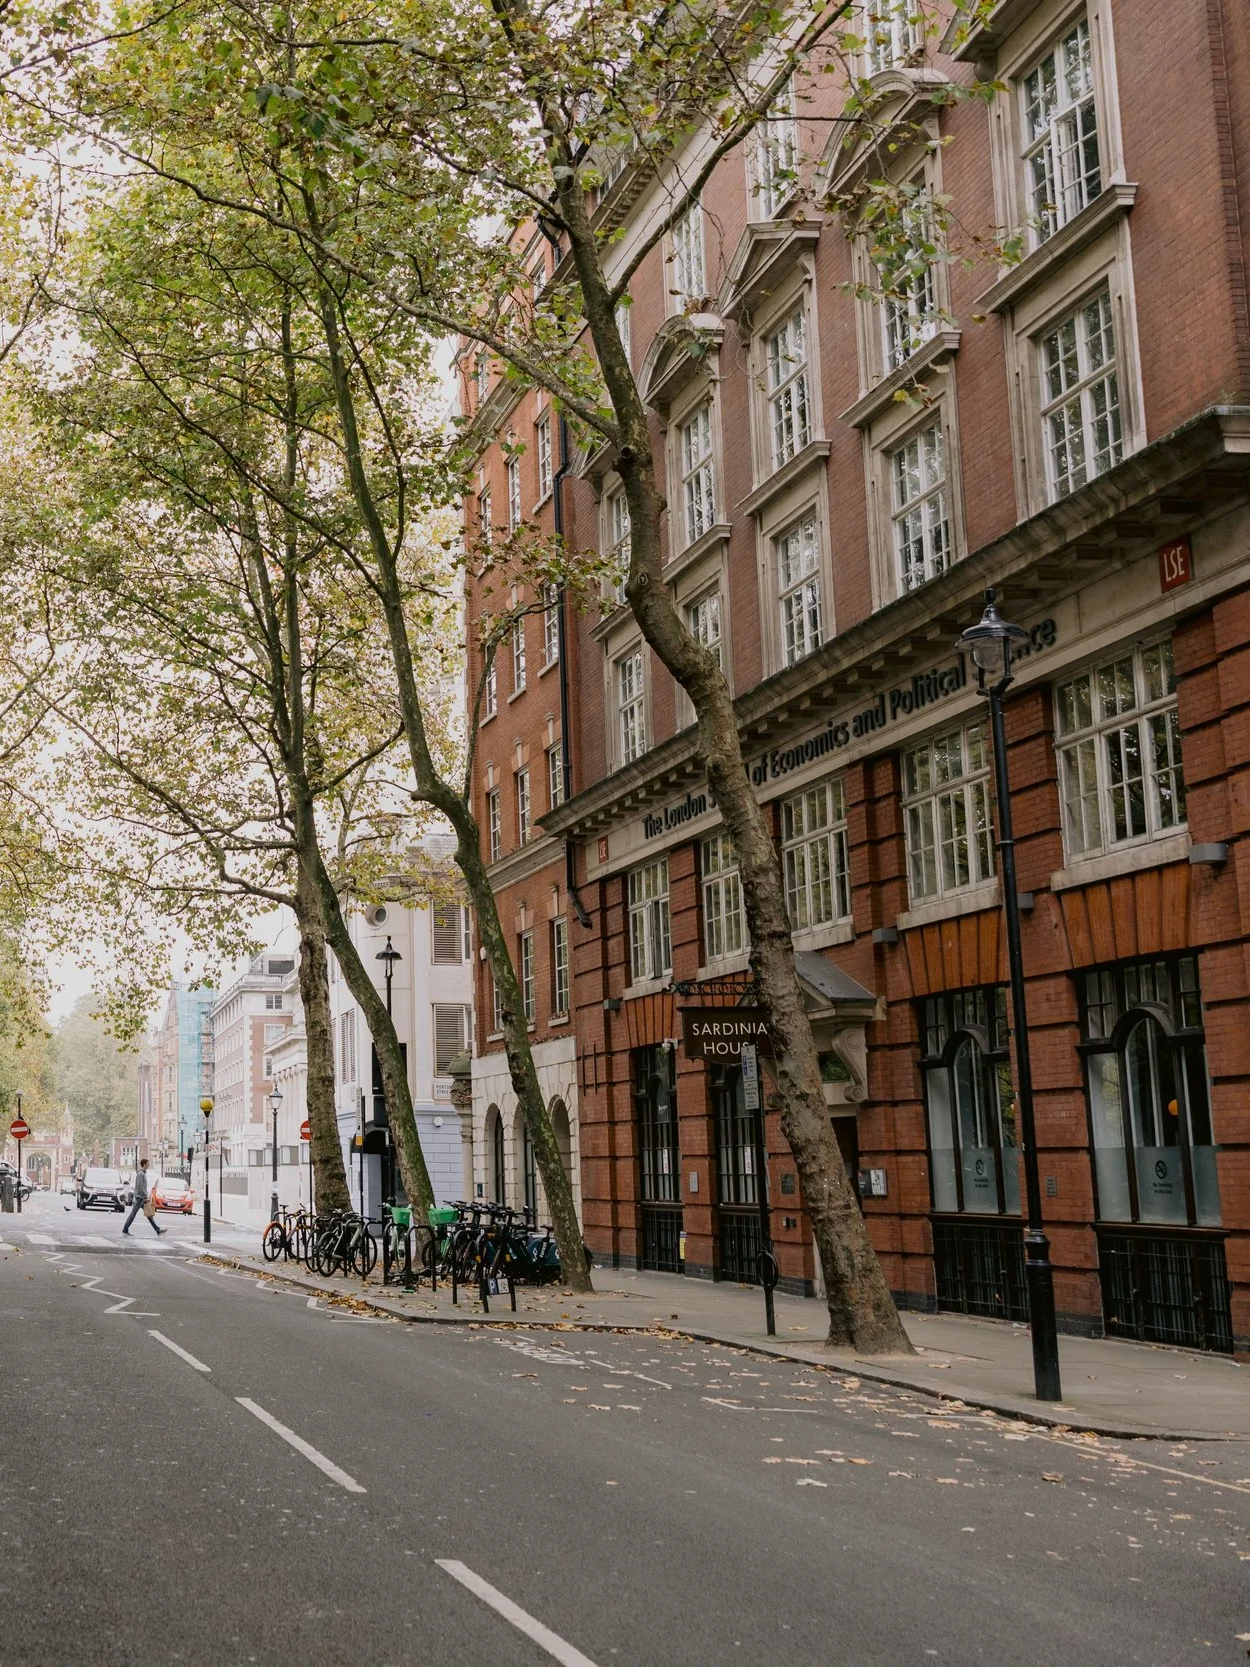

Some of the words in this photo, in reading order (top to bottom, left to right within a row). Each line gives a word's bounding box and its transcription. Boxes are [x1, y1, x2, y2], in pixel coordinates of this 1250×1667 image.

[1163, 546, 1185, 583] LSE
[642, 813, 662, 840] The
[663, 792, 707, 830] London
[752, 752, 768, 787] of
[770, 720, 849, 779] Economics
[852, 694, 887, 738] and
[889, 652, 967, 720] Political
[692, 1022, 768, 1036] SARDINIA
[703, 1041, 759, 1055] HOU
[539, 1241, 548, 1258] forest
